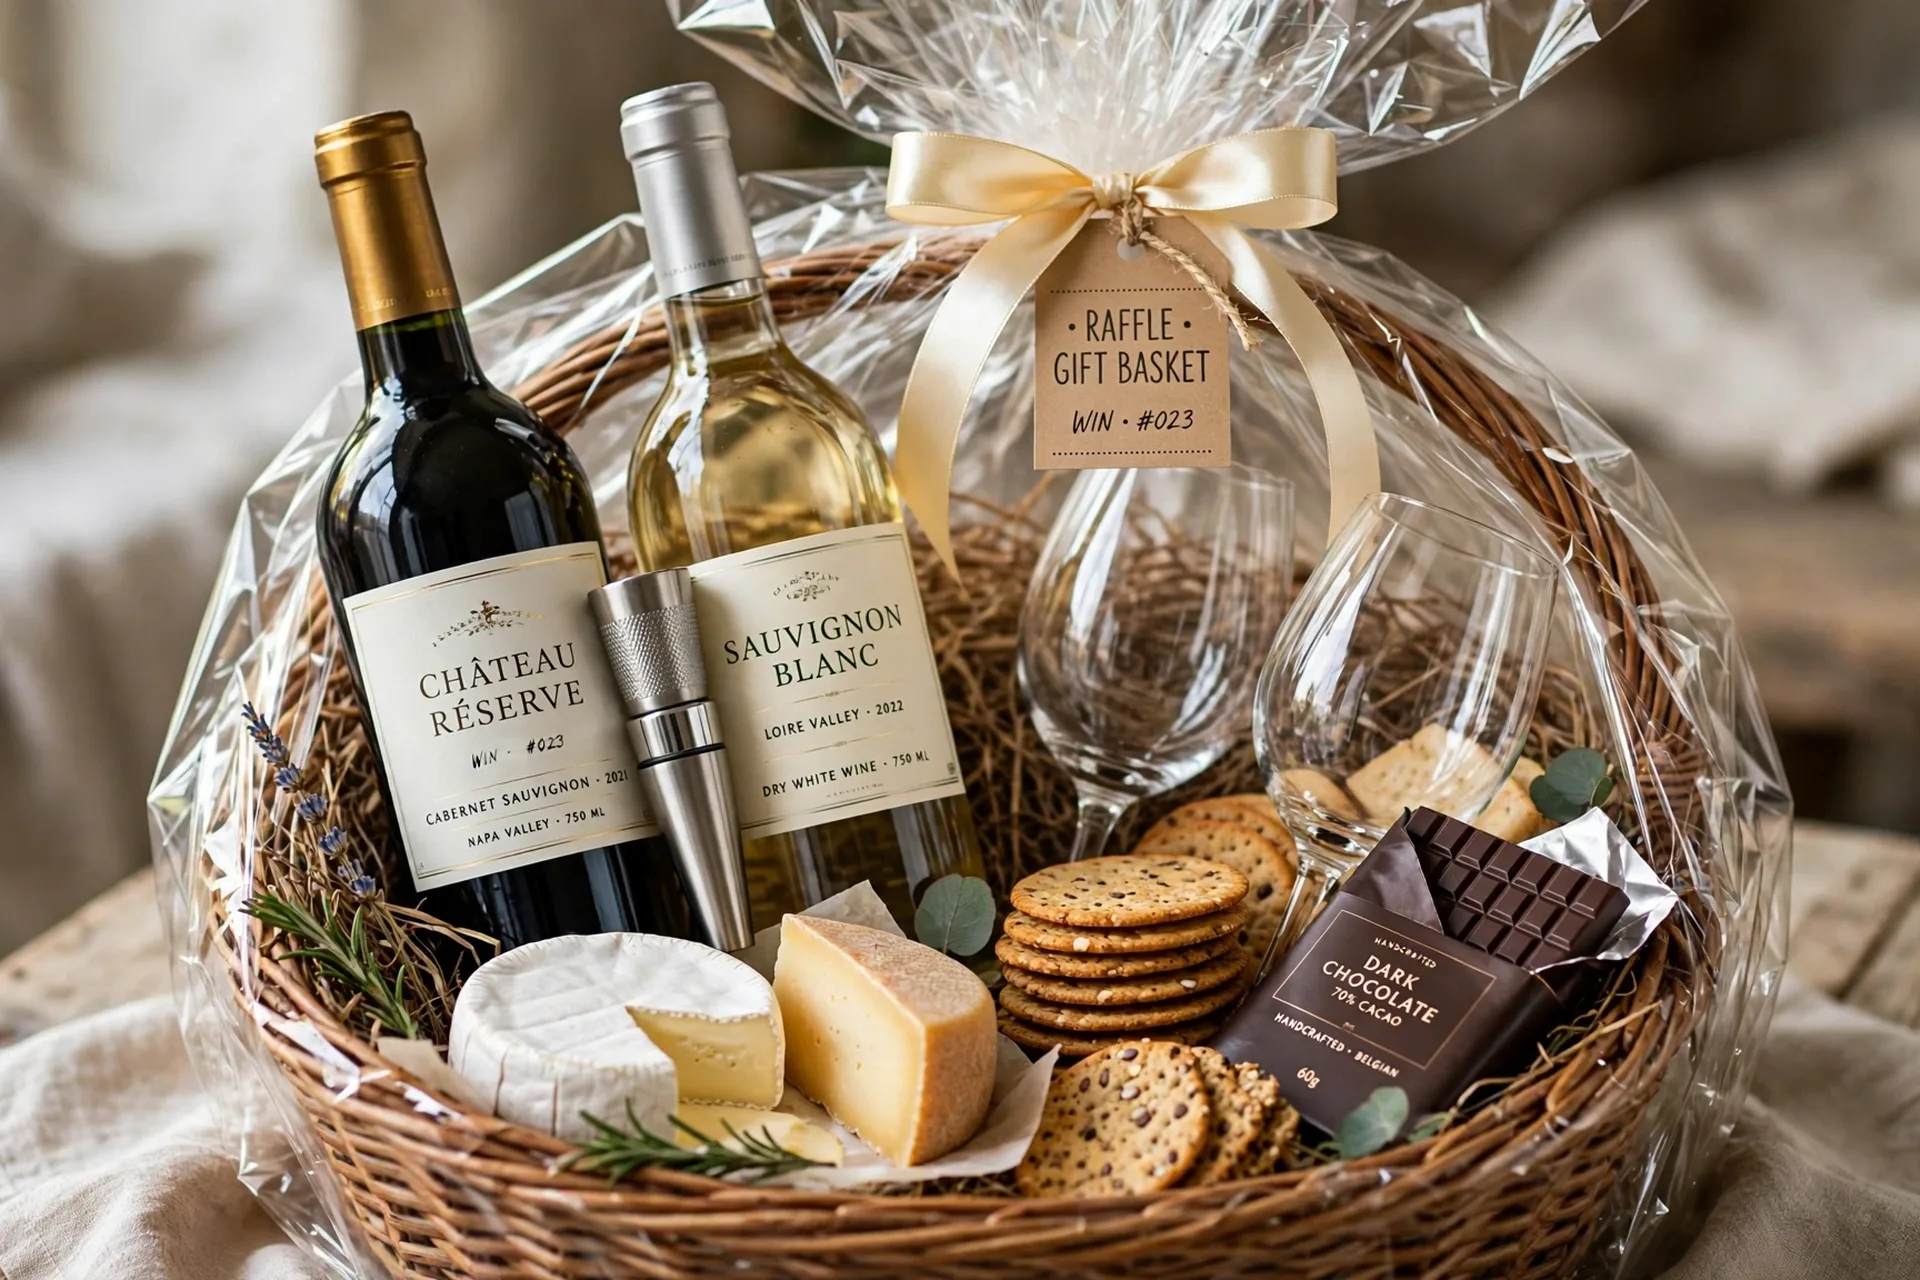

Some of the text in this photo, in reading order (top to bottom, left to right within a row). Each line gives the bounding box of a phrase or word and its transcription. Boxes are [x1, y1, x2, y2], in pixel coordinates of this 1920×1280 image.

[1086, 308, 1174, 342] RAFFLE
[1054, 350, 1210, 385] GIFT BASKET
[1072, 409, 1194, 434] WIN #023
[723, 604, 902, 665] SAUVIGNON
[419, 642, 576, 699] CHÂTEAU
[772, 643, 879, 687] BLANC
[429, 680, 584, 737] RÉSERVE
[764, 700, 904, 740] LOIRE VALLEY 2022
[472, 734, 564, 769] WIN #023
[762, 750, 930, 797] DRY WHITE WINE 750 ML
[426, 769, 628, 826] CABERNET SAUVIGNON 2021
[468, 807, 605, 848] NAPA VALLEY 750 ML
[1322, 960, 1439, 1024] CHOCOLATE
[1363, 954, 1420, 991] DARK
[1331, 986, 1402, 1027] 70% CACAO
[1274, 1012, 1400, 1079] HANDCRAFTED BELGIAN
[1296, 1066, 1321, 1090] 60g
